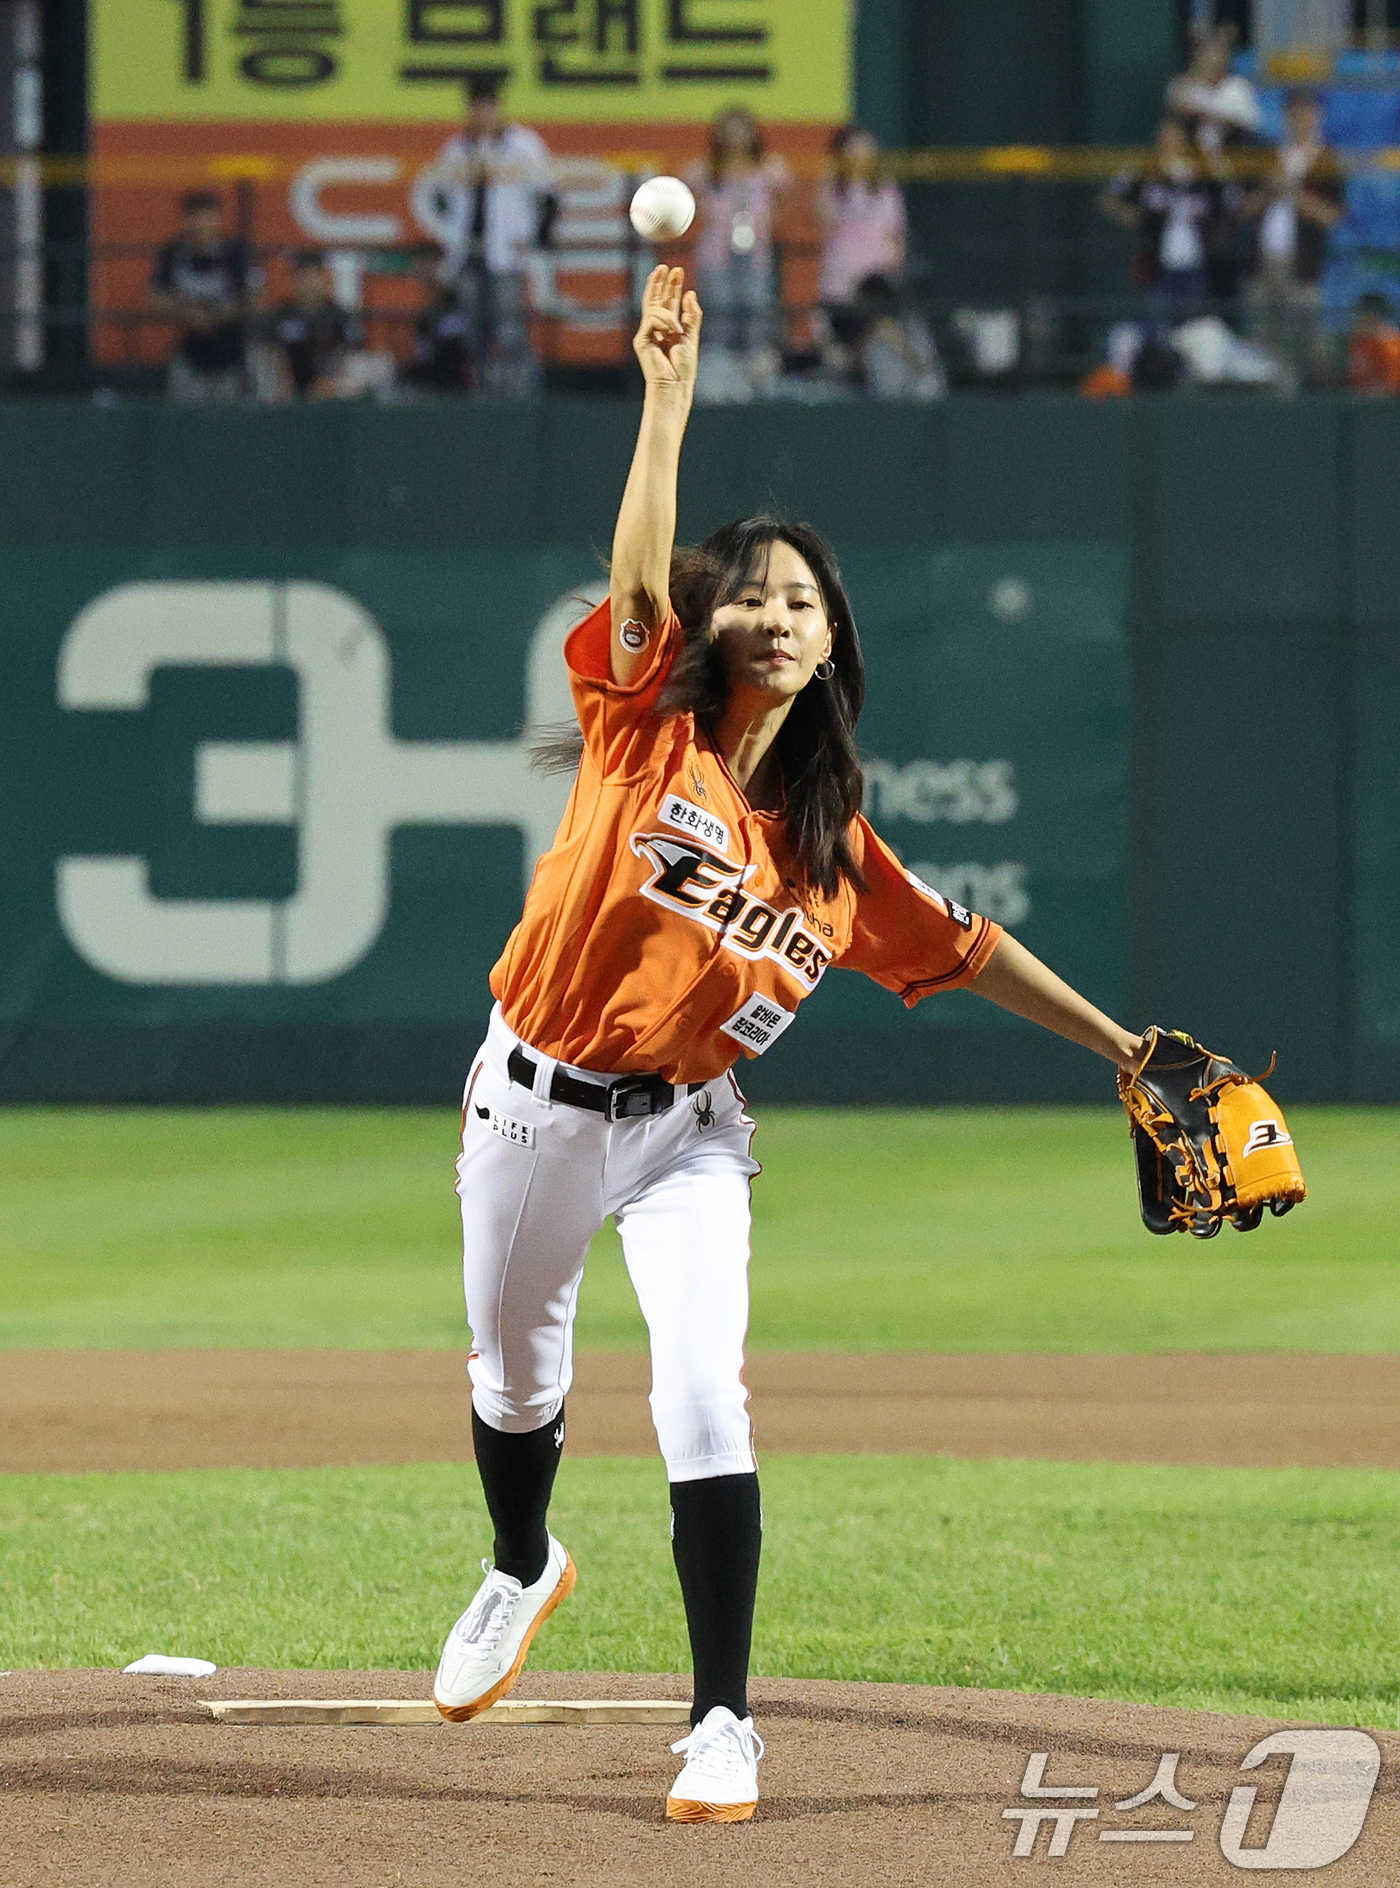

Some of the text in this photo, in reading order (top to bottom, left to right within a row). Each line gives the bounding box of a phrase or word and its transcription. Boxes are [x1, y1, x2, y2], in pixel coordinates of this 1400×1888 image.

[669, 802, 725, 846] 한화생명
[632, 835, 829, 983] Eagles
[750, 1004, 782, 1029] 알바몬
[731, 1016, 772, 1046] 잡코리아
[493, 1125, 527, 1143] PLUS
[494, 1115, 528, 1134] LIFE
